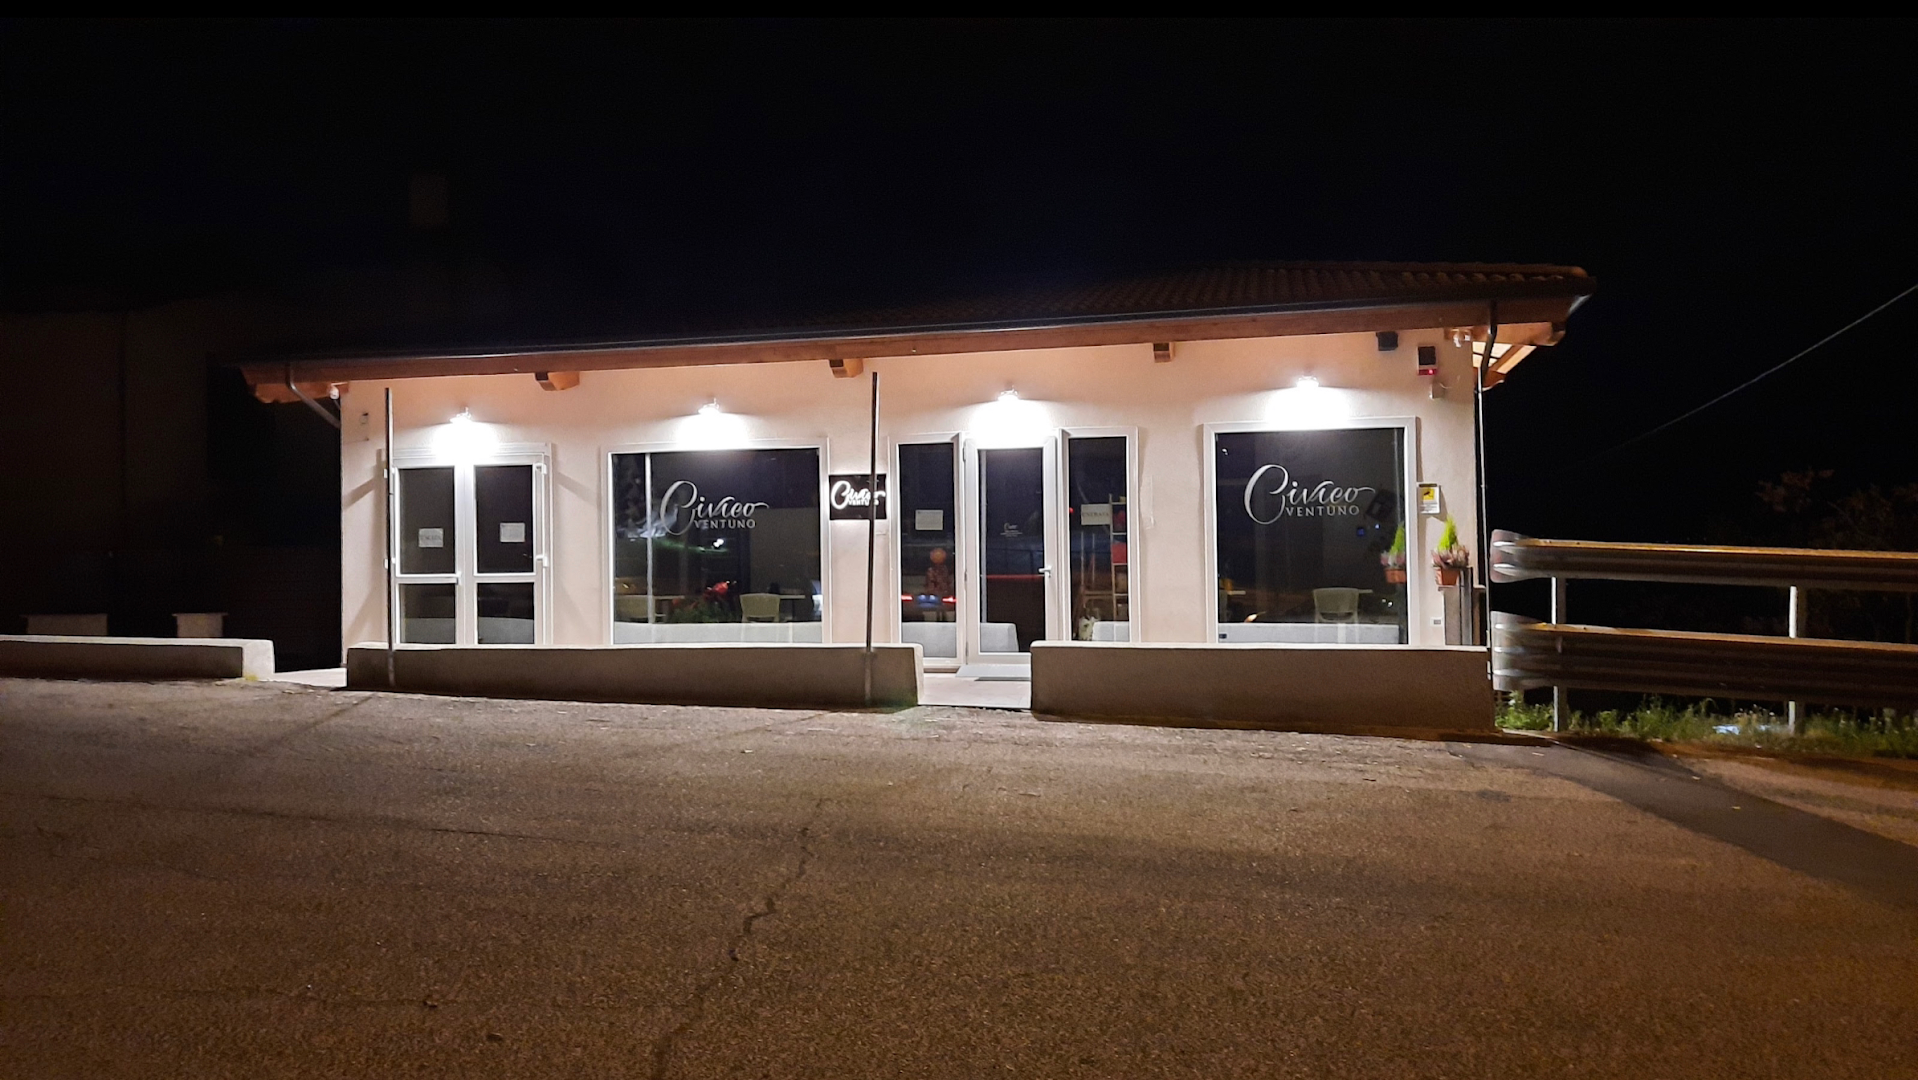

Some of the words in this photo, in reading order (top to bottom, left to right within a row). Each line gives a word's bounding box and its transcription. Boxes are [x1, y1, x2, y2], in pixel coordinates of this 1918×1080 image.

[660, 480, 769, 536] Civico
[1244, 464, 1376, 525] Civico
[1285, 505, 1360, 517] VENTUNO
[694, 518, 756, 530] VENTUNO
